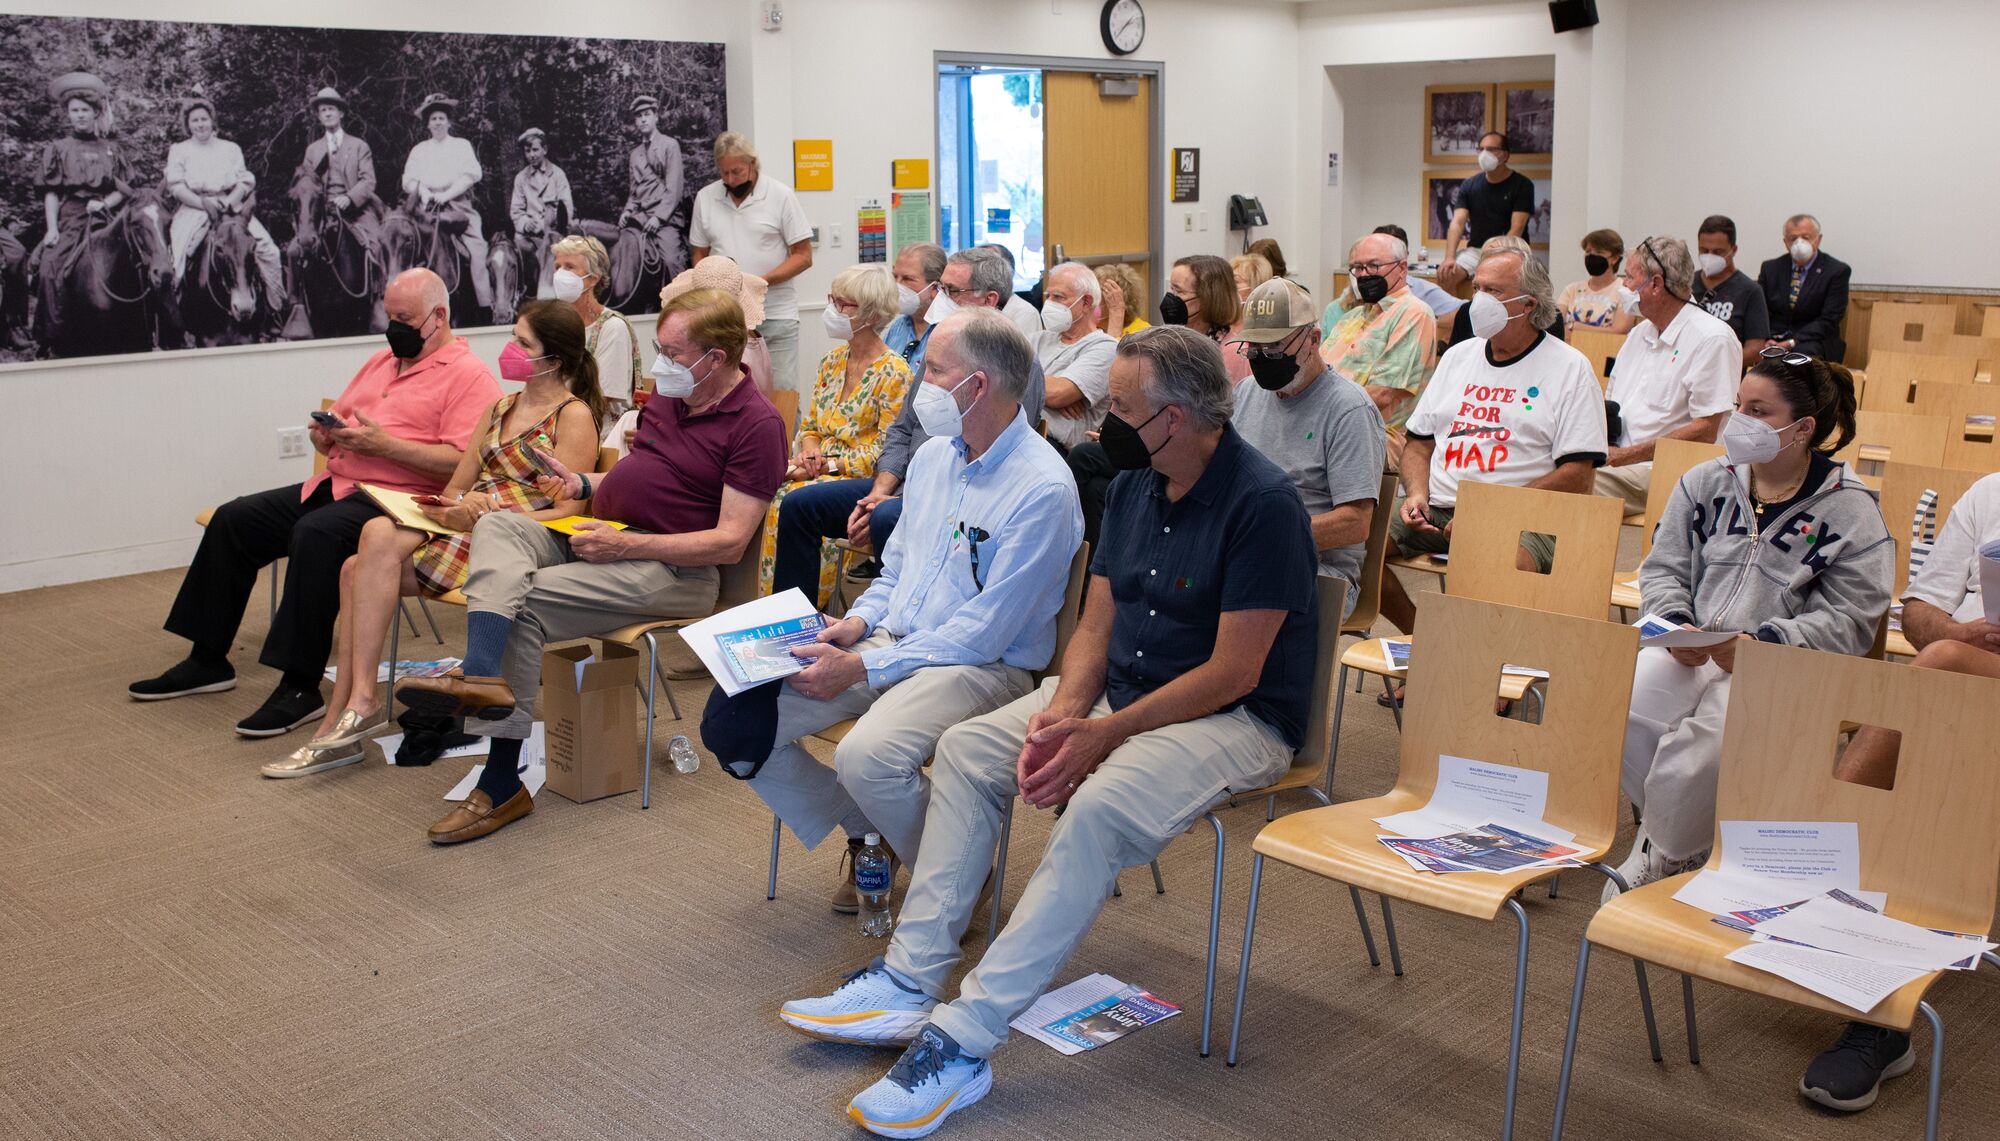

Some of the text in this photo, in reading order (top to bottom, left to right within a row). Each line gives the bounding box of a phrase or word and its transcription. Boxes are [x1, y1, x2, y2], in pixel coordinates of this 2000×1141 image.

[1463, 383, 1517, 404] VOTE
[1457, 401, 1501, 424] FOR
[1444, 440, 1509, 473] HAP
[1687, 496, 1842, 565] RILEY
